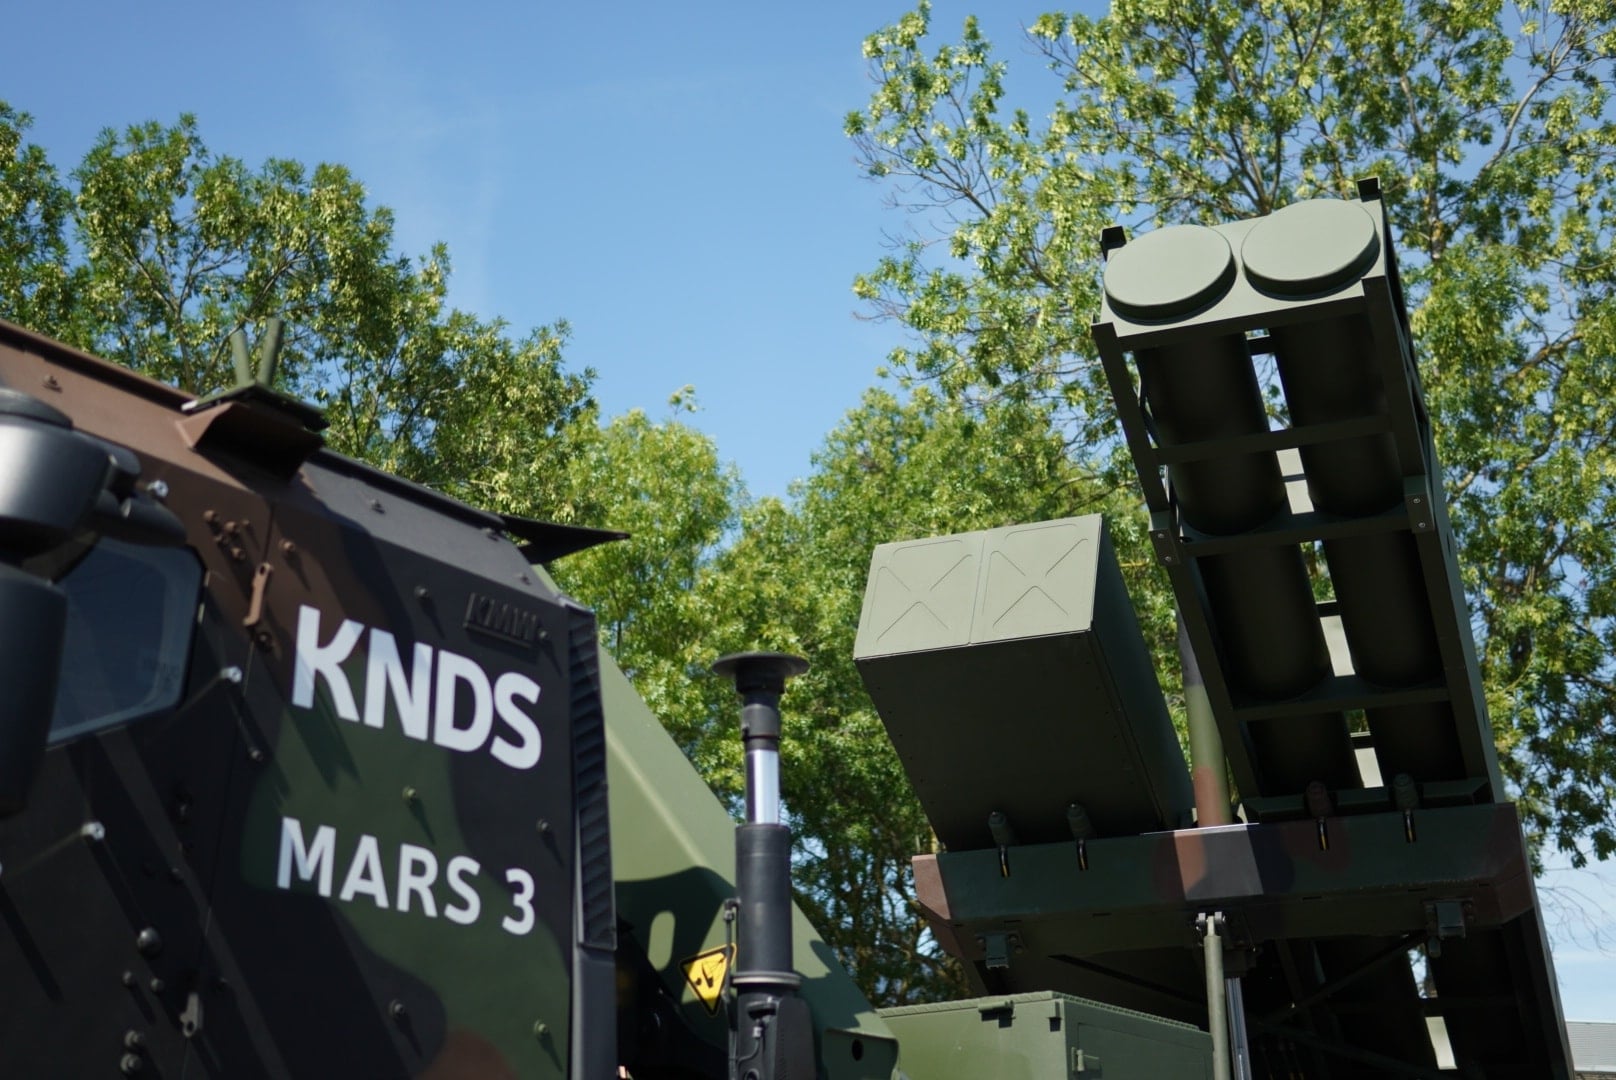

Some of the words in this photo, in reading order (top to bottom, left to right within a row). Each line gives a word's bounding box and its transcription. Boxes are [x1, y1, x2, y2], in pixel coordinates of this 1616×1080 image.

[292, 604, 542, 769] KNDS
[277, 816, 482, 925] MARS
[502, 868, 536, 935] 3
